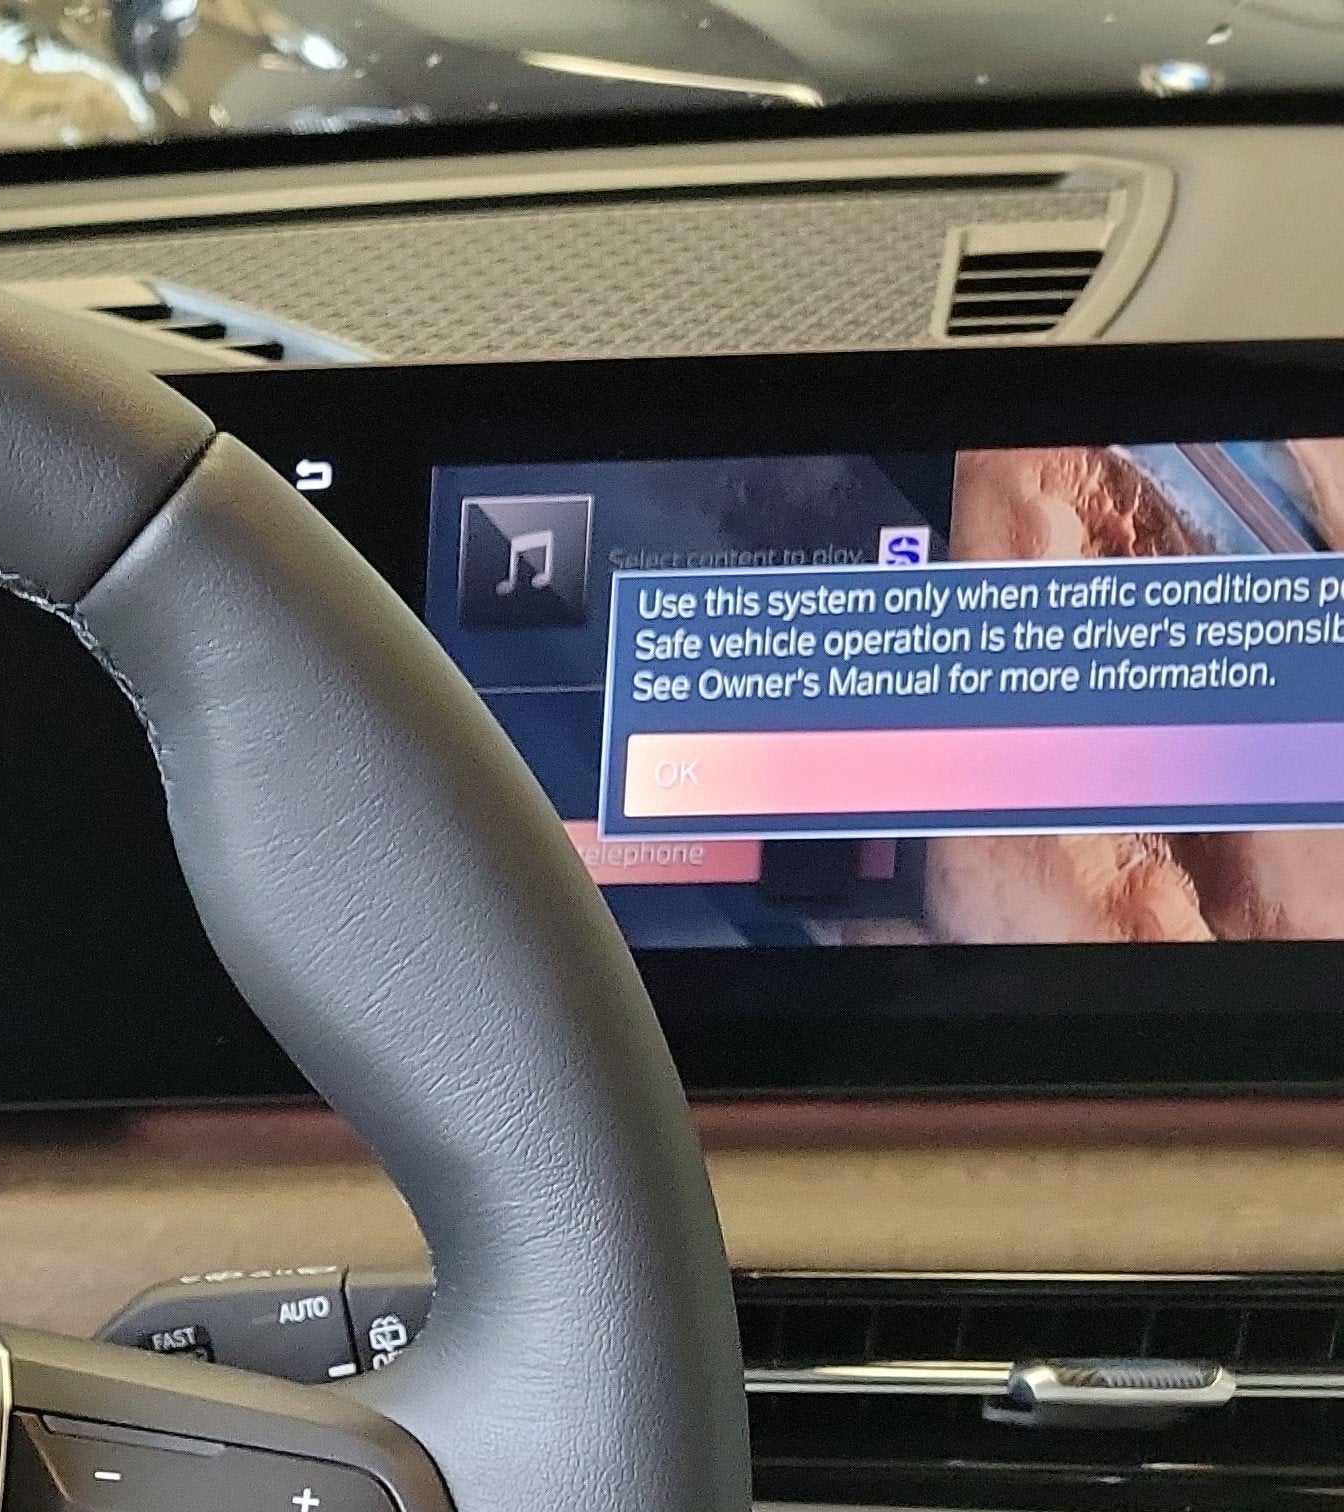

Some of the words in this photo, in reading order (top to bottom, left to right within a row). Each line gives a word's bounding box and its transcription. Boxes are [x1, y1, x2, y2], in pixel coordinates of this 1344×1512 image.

[638, 588, 697, 620] Use
[705, 586, 760, 616] this
[767, 585, 876, 622] system
[884, 581, 950, 618] only
[956, 579, 1039, 611] when
[1047, 574, 1138, 609] traffic
[1144, 571, 1310, 607] conditions
[635, 628, 702, 661] Safe
[710, 626, 816, 658] vehicle
[824, 622, 971, 661] operation
[980, 621, 1005, 651] is
[1013, 620, 1064, 651] the
[1072, 617, 1186, 649] driver's
[633, 671, 691, 702] See
[698, 667, 820, 700] Owner's
[828, 663, 941, 697] Manual
[948, 661, 993, 694] for
[999, 662, 1080, 693] more
[1089, 655, 1277, 690] information.
[654, 759, 700, 788] OK
[576, 842, 705, 868] elephone
[278, 1295, 330, 1325] AUTO
[150, 1327, 196, 1351] FAST
